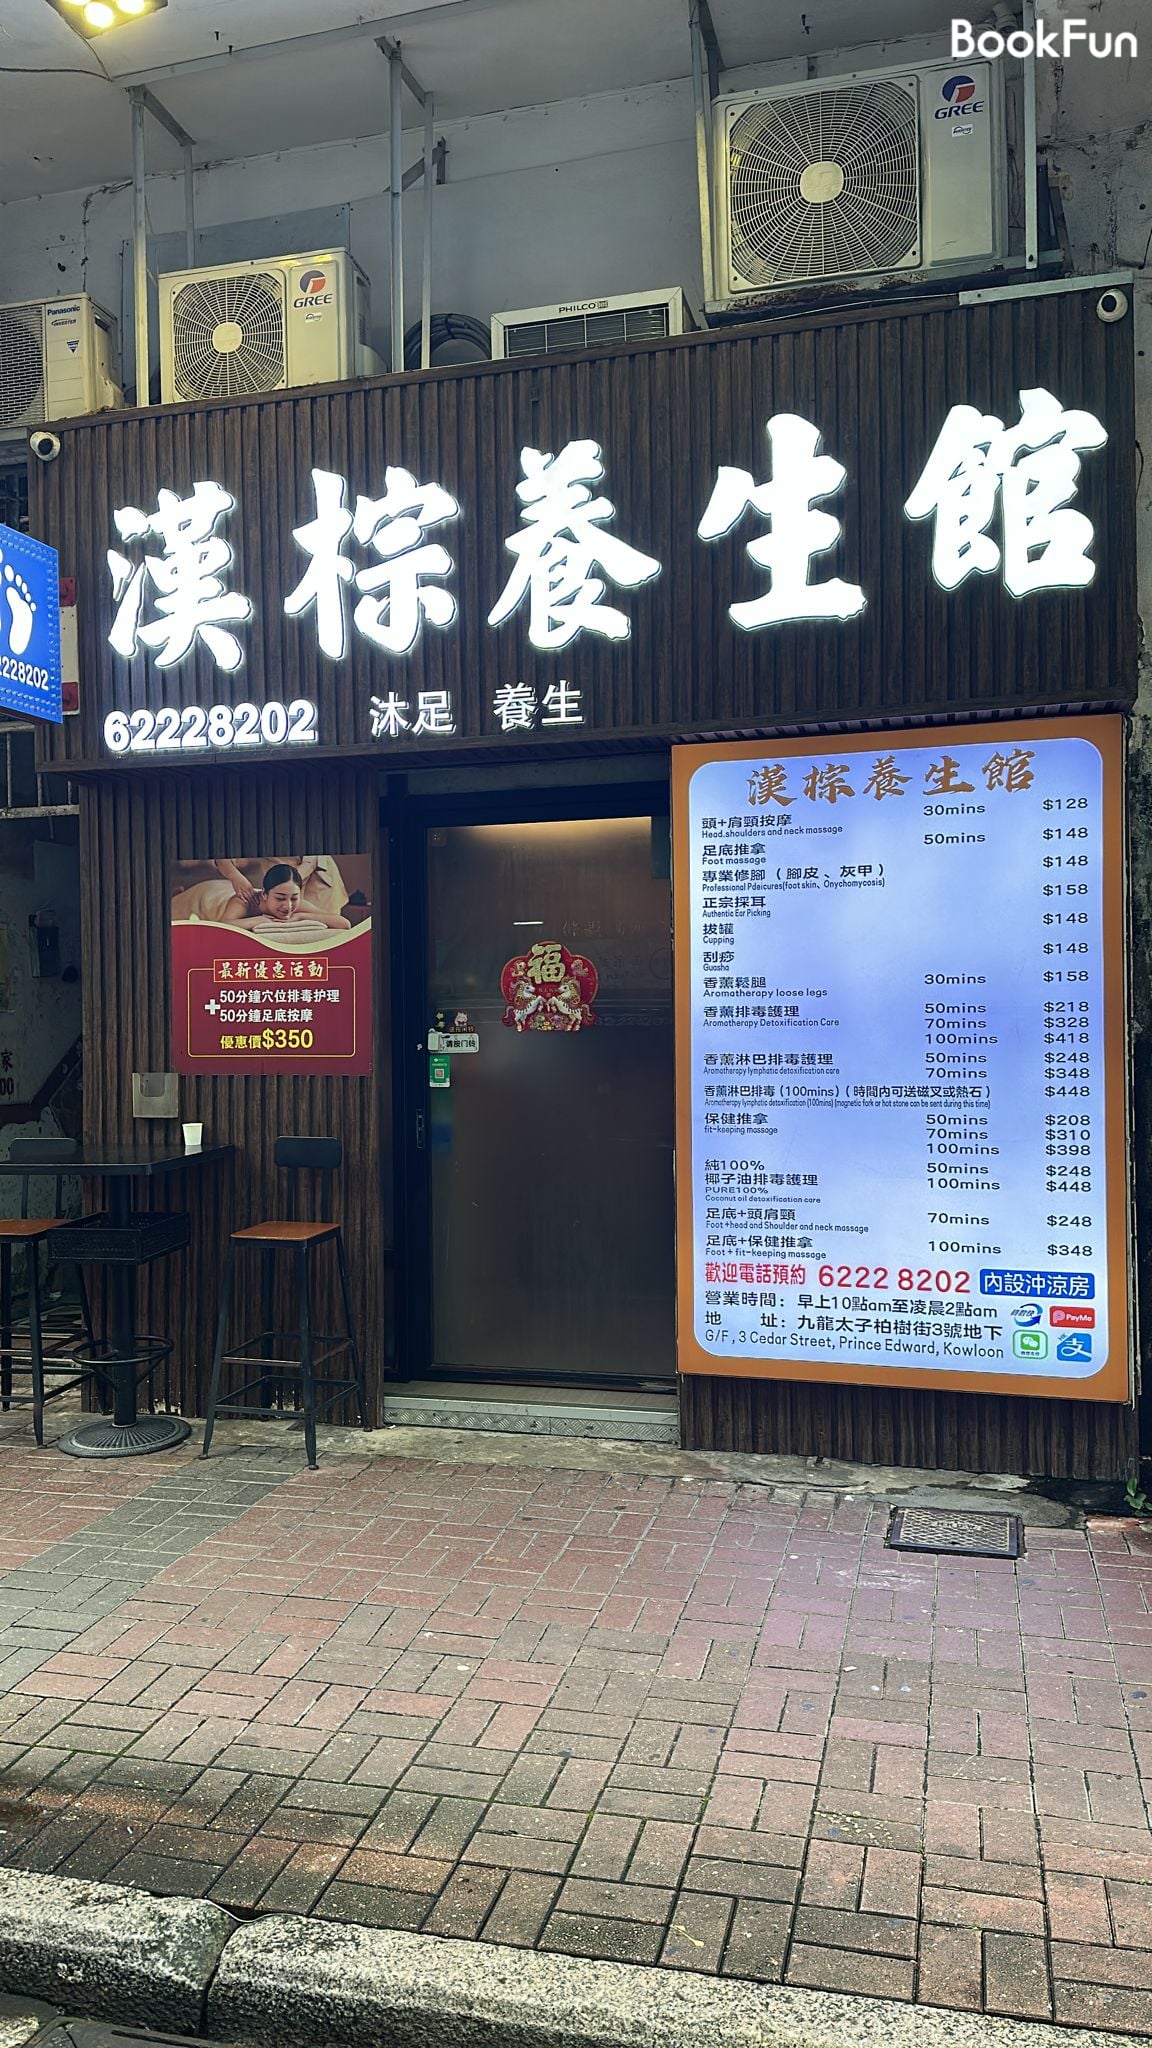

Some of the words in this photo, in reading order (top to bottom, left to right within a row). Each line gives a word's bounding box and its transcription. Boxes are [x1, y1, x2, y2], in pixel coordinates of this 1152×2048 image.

[934, 100, 985, 120] GREE
[293, 293, 333, 309] GREE
[558, 302, 596, 313] PHILCO
[47, 305, 81, 316] Panasonic
[106, 387, 1110, 673] 漢棕養生館
[0, 654, 48, 691] 228202
[103, 698, 318, 753] 62228202
[369, 689, 455, 736] 沐足
[493, 679, 584, 732] 養生
[746, 748, 1036, 806] 漢棕養生館
[923, 803, 986, 816] 30mins
[1042, 798, 1089, 811] $128
[702, 813, 792, 829] 頭+肩頸按摩
[767, 828, 783, 836] and
[783, 826, 804, 836] neck
[805, 825, 843, 835] massage
[1042, 827, 1089, 840] $148
[924, 832, 986, 845] 50mins
[702, 842, 766, 857] 足底推拿
[702, 857, 723, 865] Foot
[725, 857, 767, 866] massage
[1042, 855, 1089, 868] $148
[702, 882, 746, 892] Professional
[1042, 884, 1089, 896] $158
[702, 896, 766, 909] 正宗採耳
[702, 909, 734, 919] Authentic
[735, 909, 746, 918] Ear
[746, 909, 771, 919] Picking
[1042, 913, 1089, 925] $148
[702, 923, 734, 935] 拔罐
[702, 936, 735, 946] Cupping
[1042, 942, 1089, 955] $148
[703, 950, 735, 963] 刮痧
[218, 960, 324, 980] 最新優惠活動
[527, 943, 566, 985] 福
[703, 963, 730, 971] Guasha
[924, 973, 987, 985] 30mins
[1043, 970, 1089, 983] $158
[703, 989, 774, 999] Aromatherapy
[776, 988, 804, 997] loose
[806, 988, 828, 998] legs
[703, 1005, 800, 1018] 香薰排毒護理
[924, 1002, 987, 1014] 50mins
[1043, 1001, 1090, 1013] $218
[219, 1008, 314, 1023] 50分鐘足底按摩
[703, 1018, 759, 1029] Aromatherapy
[760, 1018, 819, 1027] Detoxification
[820, 1018, 840, 1026] Care
[924, 1017, 987, 1029] 70mins
[1043, 1016, 1090, 1029] $328
[925, 1032, 999, 1044] 100mins
[1043, 1032, 1090, 1044] $418
[703, 1053, 834, 1066] 香薰淋巴排毒護理
[925, 1051, 988, 1063] 50mins
[1044, 1052, 1090, 1064] $248
[703, 1066, 747, 1076] Aromatherapy
[747, 1066, 779, 1076] lymphatic
[779, 1066, 825, 1075] detoxification
[825, 1067, 840, 1075] care
[925, 1067, 988, 1079] 70mins
[1044, 1067, 1091, 1079] $348
[1044, 1085, 1091, 1098] $448
[704, 1112, 768, 1125] 保健推拿
[926, 1114, 988, 1126] 50mins
[1044, 1115, 1091, 1127] $208
[704, 1125, 745, 1135] fit-keeping
[746, 1127, 778, 1135] massage
[926, 1128, 989, 1140] 70mins
[1044, 1129, 1091, 1141] $310
[927, 1143, 1000, 1155] 100mins
[1045, 1144, 1091, 1157] $398
[704, 1159, 765, 1171] 純100%
[926, 1162, 989, 1175] 50mins
[1045, 1165, 1092, 1178] $248
[704, 1173, 818, 1186] 椰子油排毒護理
[927, 1177, 1001, 1190] 100mins
[1045, 1180, 1092, 1193] $448
[705, 1194, 736, 1202] Coconut
[737, 1195, 748, 1203] oil
[748, 1195, 803, 1204] detoxification
[705, 1207, 796, 1221] 足底+頭肩頸
[927, 1212, 990, 1225] 70mins
[705, 1221, 723, 1229] Foot
[749, 1221, 762, 1230] and
[764, 1221, 798, 1231] Shoulder
[799, 1222, 814, 1231] and
[814, 1222, 834, 1232] neck
[834, 1225, 869, 1234] massage
[1046, 1214, 1092, 1228] $248
[706, 1234, 813, 1249] 足底+保健推拿
[928, 1240, 1002, 1255] 100mins
[705, 1247, 726, 1256] Foot
[735, 1247, 788, 1260] fit-keeping
[788, 1251, 827, 1261] massage
[1047, 1243, 1093, 1257] $348
[705, 1260, 806, 1286] 歡迎電話預約
[818, 1264, 889, 1290] 6222
[897, 1268, 971, 1294] 8202
[1066, 1313, 1092, 1323] PayMe
[738, 1330, 747, 1343] 3
[750, 1331, 787, 1345] Cedar
[790, 1332, 835, 1350] Street,
[839, 1336, 881, 1351] Prince
[885, 1339, 939, 1357] Edward,
[943, 1341, 1004, 1359] Kowloon
